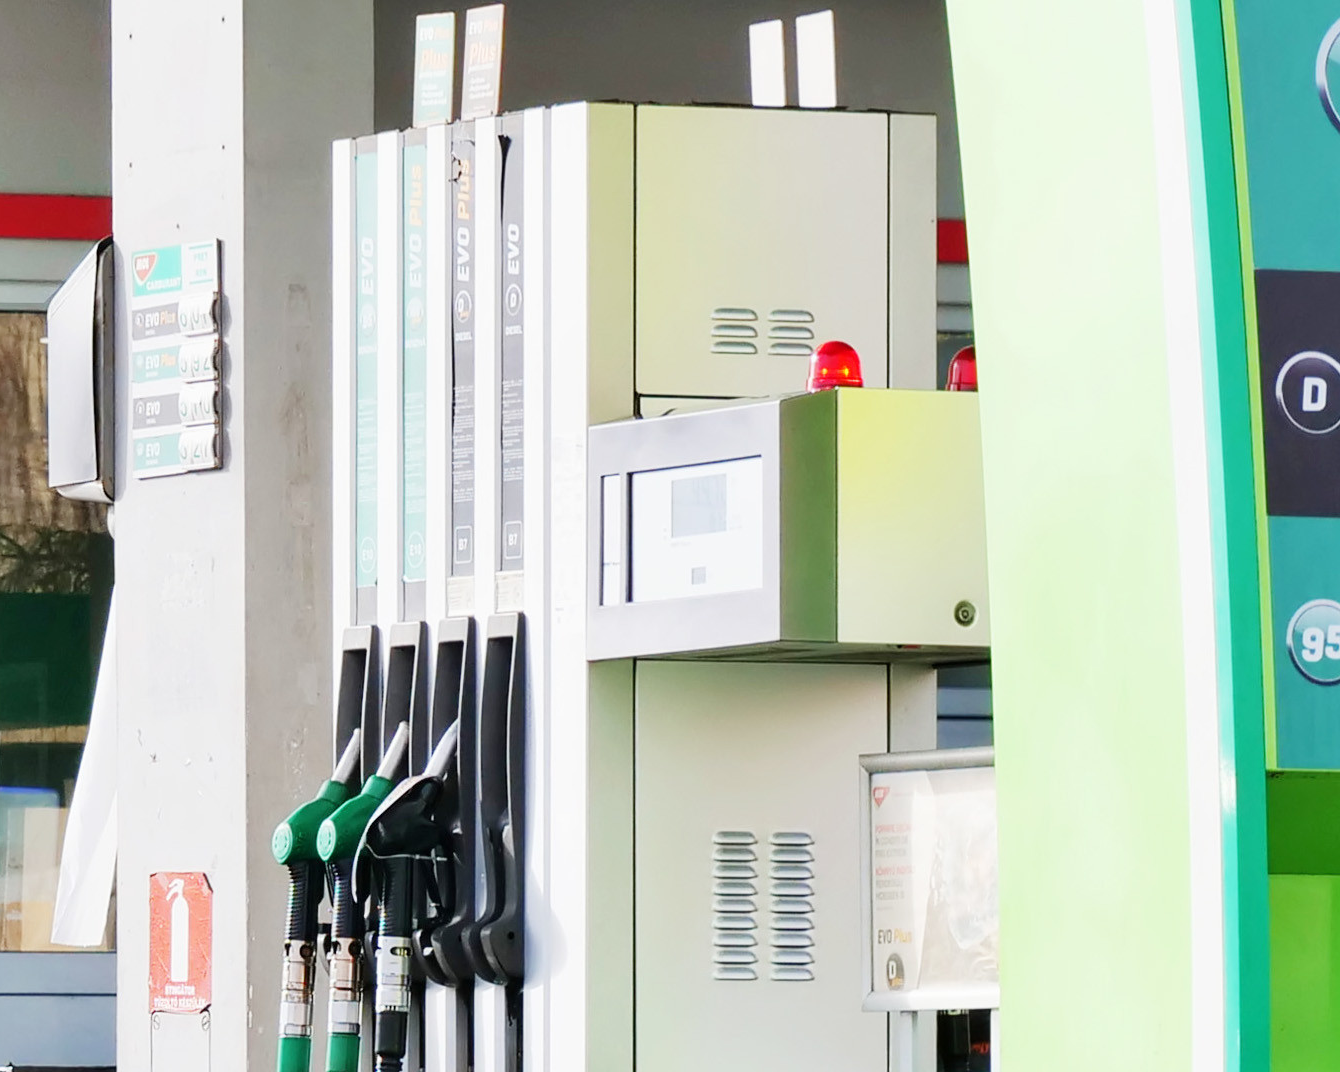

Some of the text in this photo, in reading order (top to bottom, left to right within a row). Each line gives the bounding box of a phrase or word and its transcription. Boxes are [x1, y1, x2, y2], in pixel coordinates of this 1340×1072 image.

[410, 164, 423, 227] Plus
[361, 237, 374, 295] EVO
[409, 233, 422, 288] EVO
[457, 226, 470, 282] EVO
[507, 223, 520, 275] EVO
[145, 311, 160, 329] EVO
[145, 354, 160, 370] EVO
[145, 401, 161, 416] EVO
[1302, 376, 1327, 412] D
[145, 442, 160, 457] EVO
[1301, 624, 1340, 662] 95
[877, 928, 912, 945] EVO Plus
